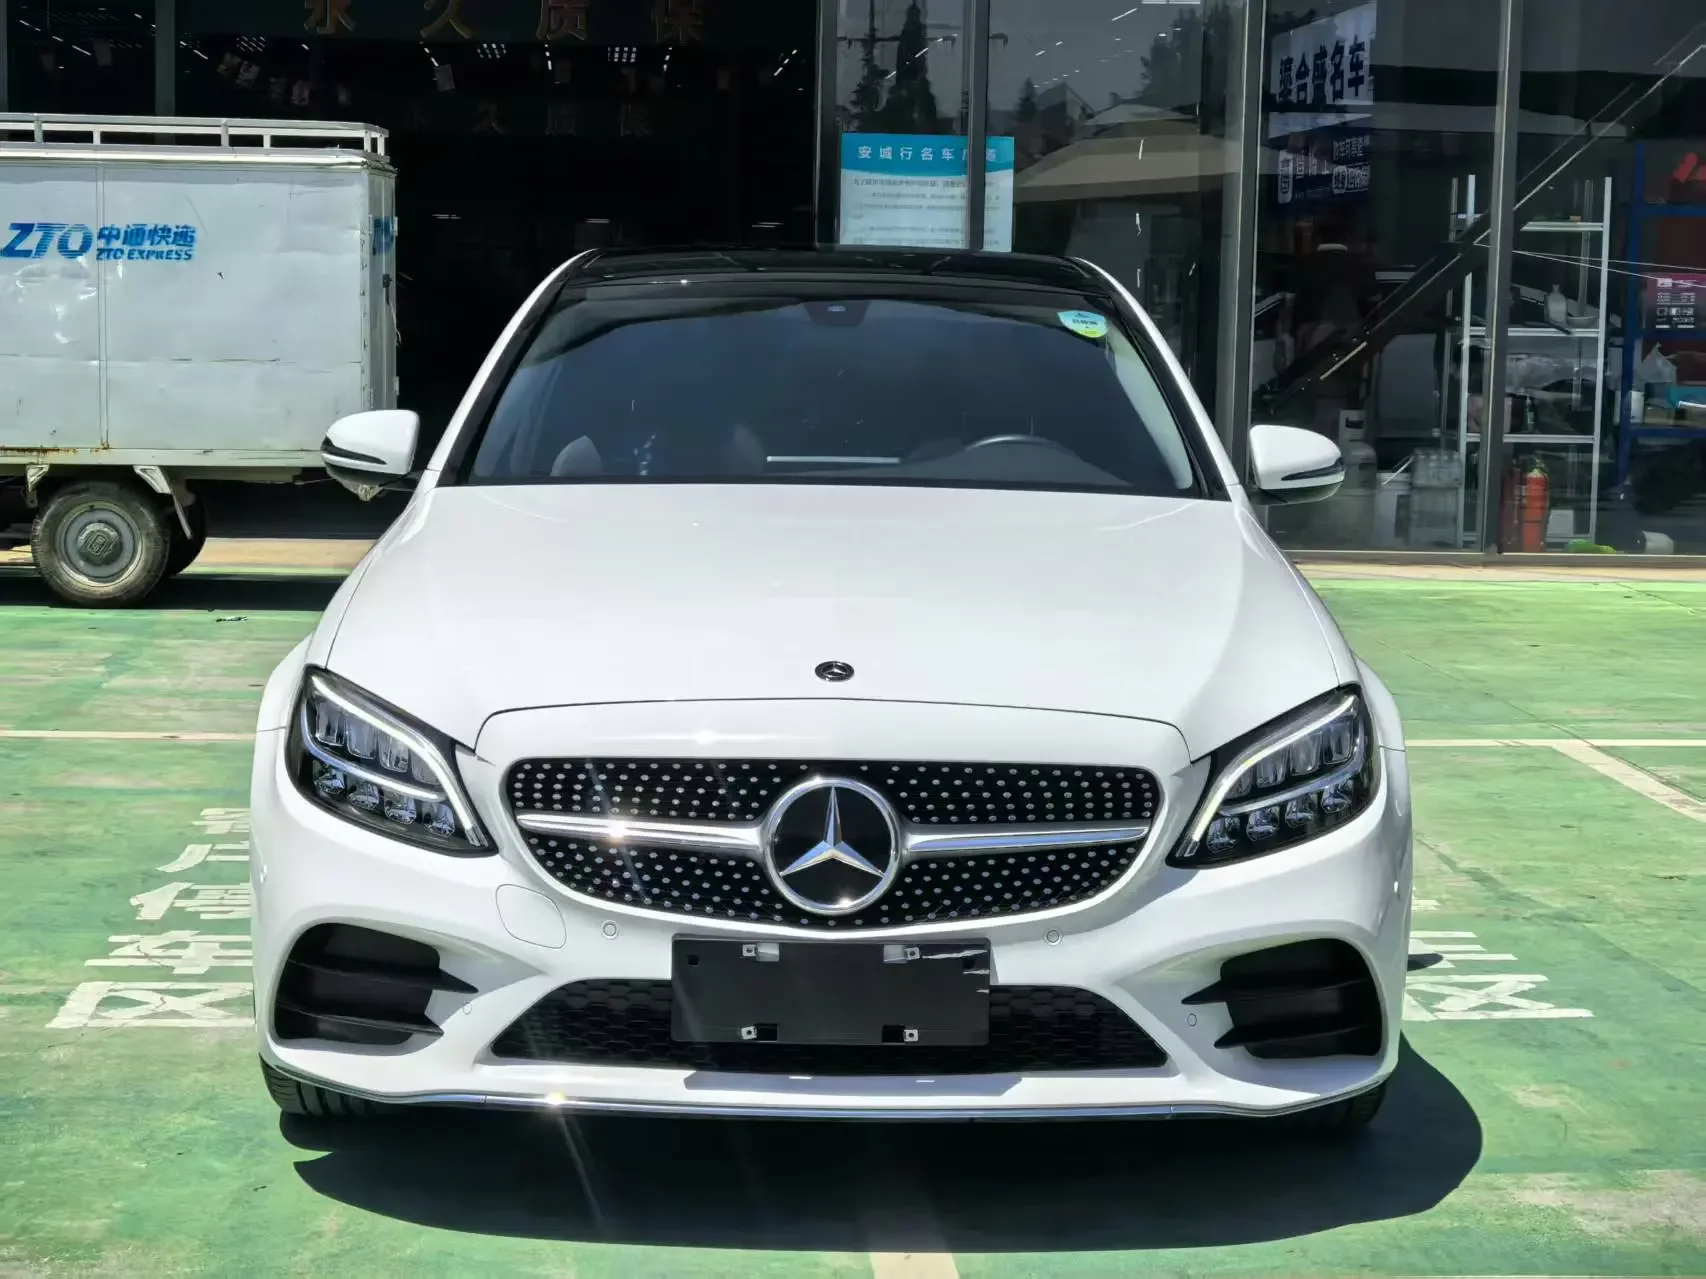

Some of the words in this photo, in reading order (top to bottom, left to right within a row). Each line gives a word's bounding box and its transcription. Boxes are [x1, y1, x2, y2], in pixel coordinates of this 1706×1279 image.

[0, 222, 93, 260] ZTO
[96, 223, 197, 247] 中通快递
[95, 248, 124, 260] ZTO
[127, 248, 193, 260] EXPRESS
